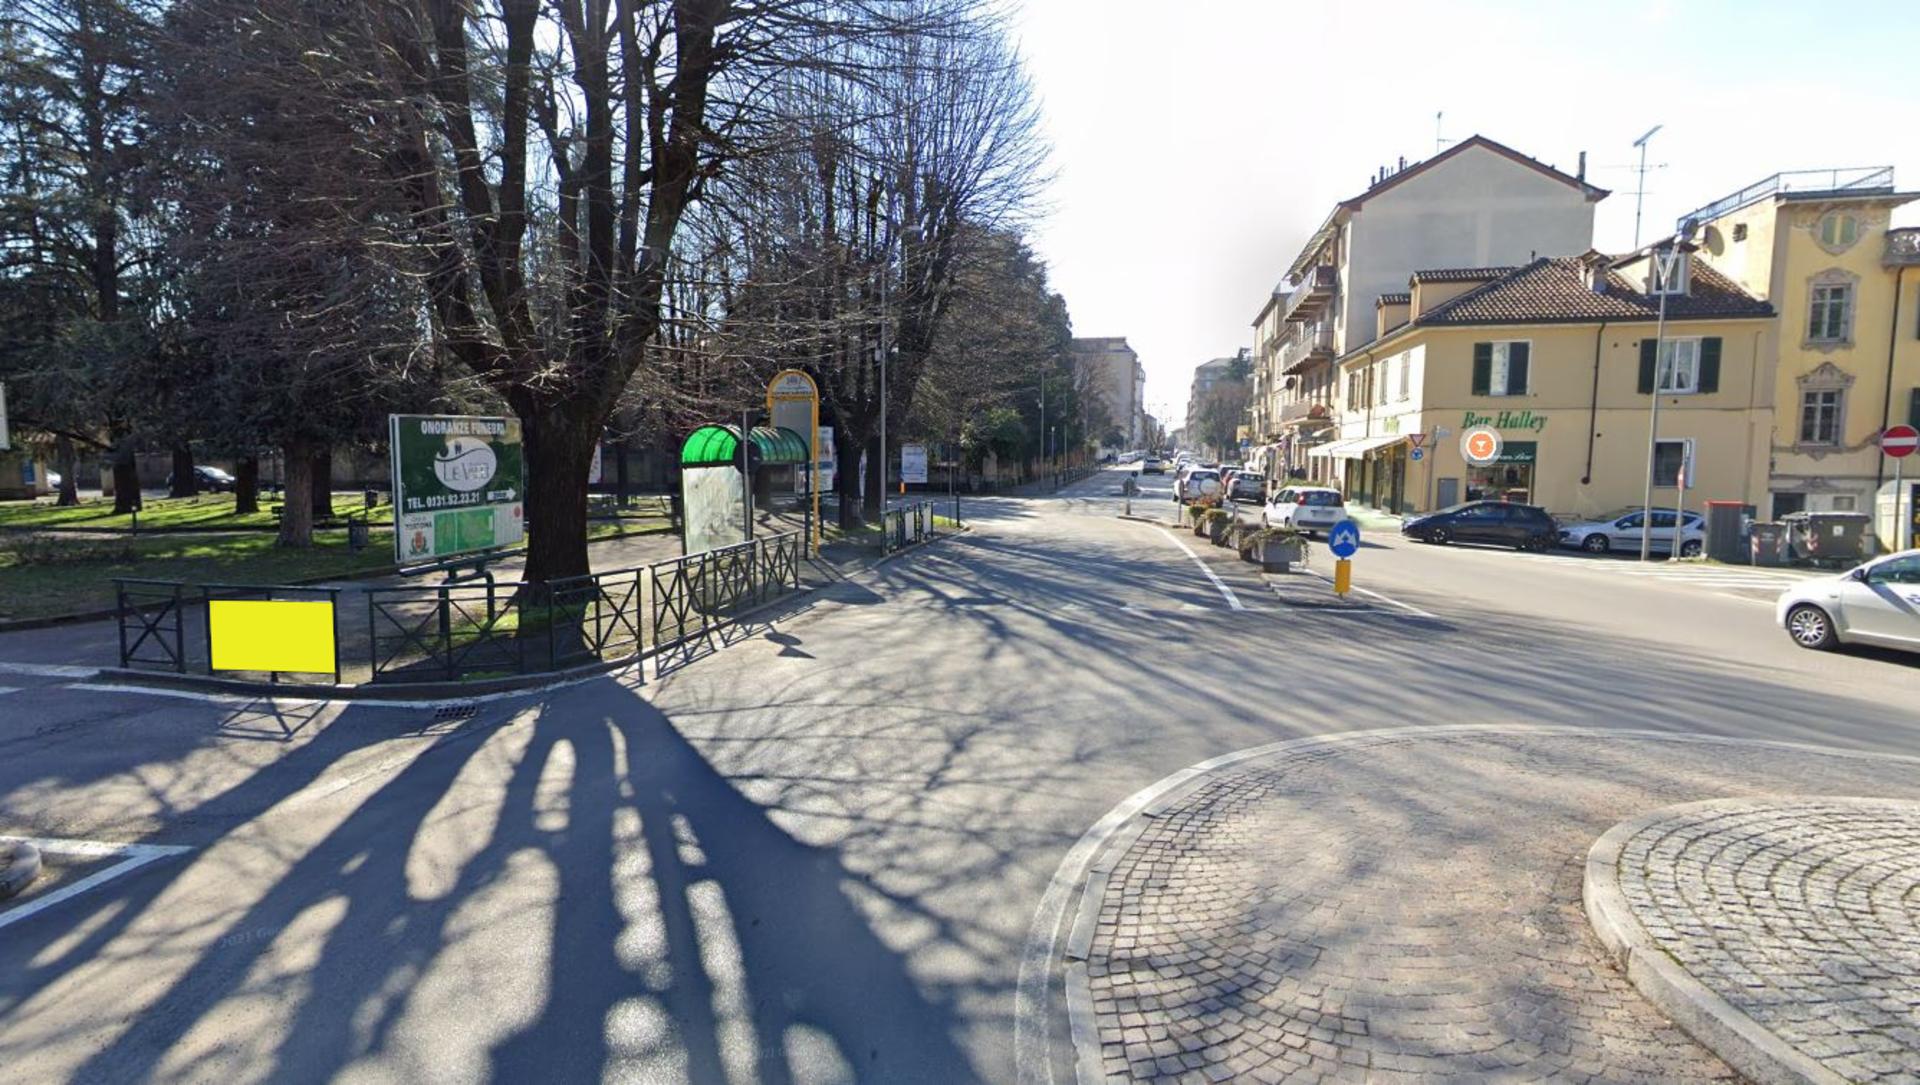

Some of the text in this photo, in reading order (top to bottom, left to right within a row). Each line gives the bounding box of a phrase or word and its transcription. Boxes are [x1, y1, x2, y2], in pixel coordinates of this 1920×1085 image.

[421, 420, 470, 435] ONORANZE
[1461, 411, 1548, 433] Bar Halley
[407, 497, 426, 509] TEL.
